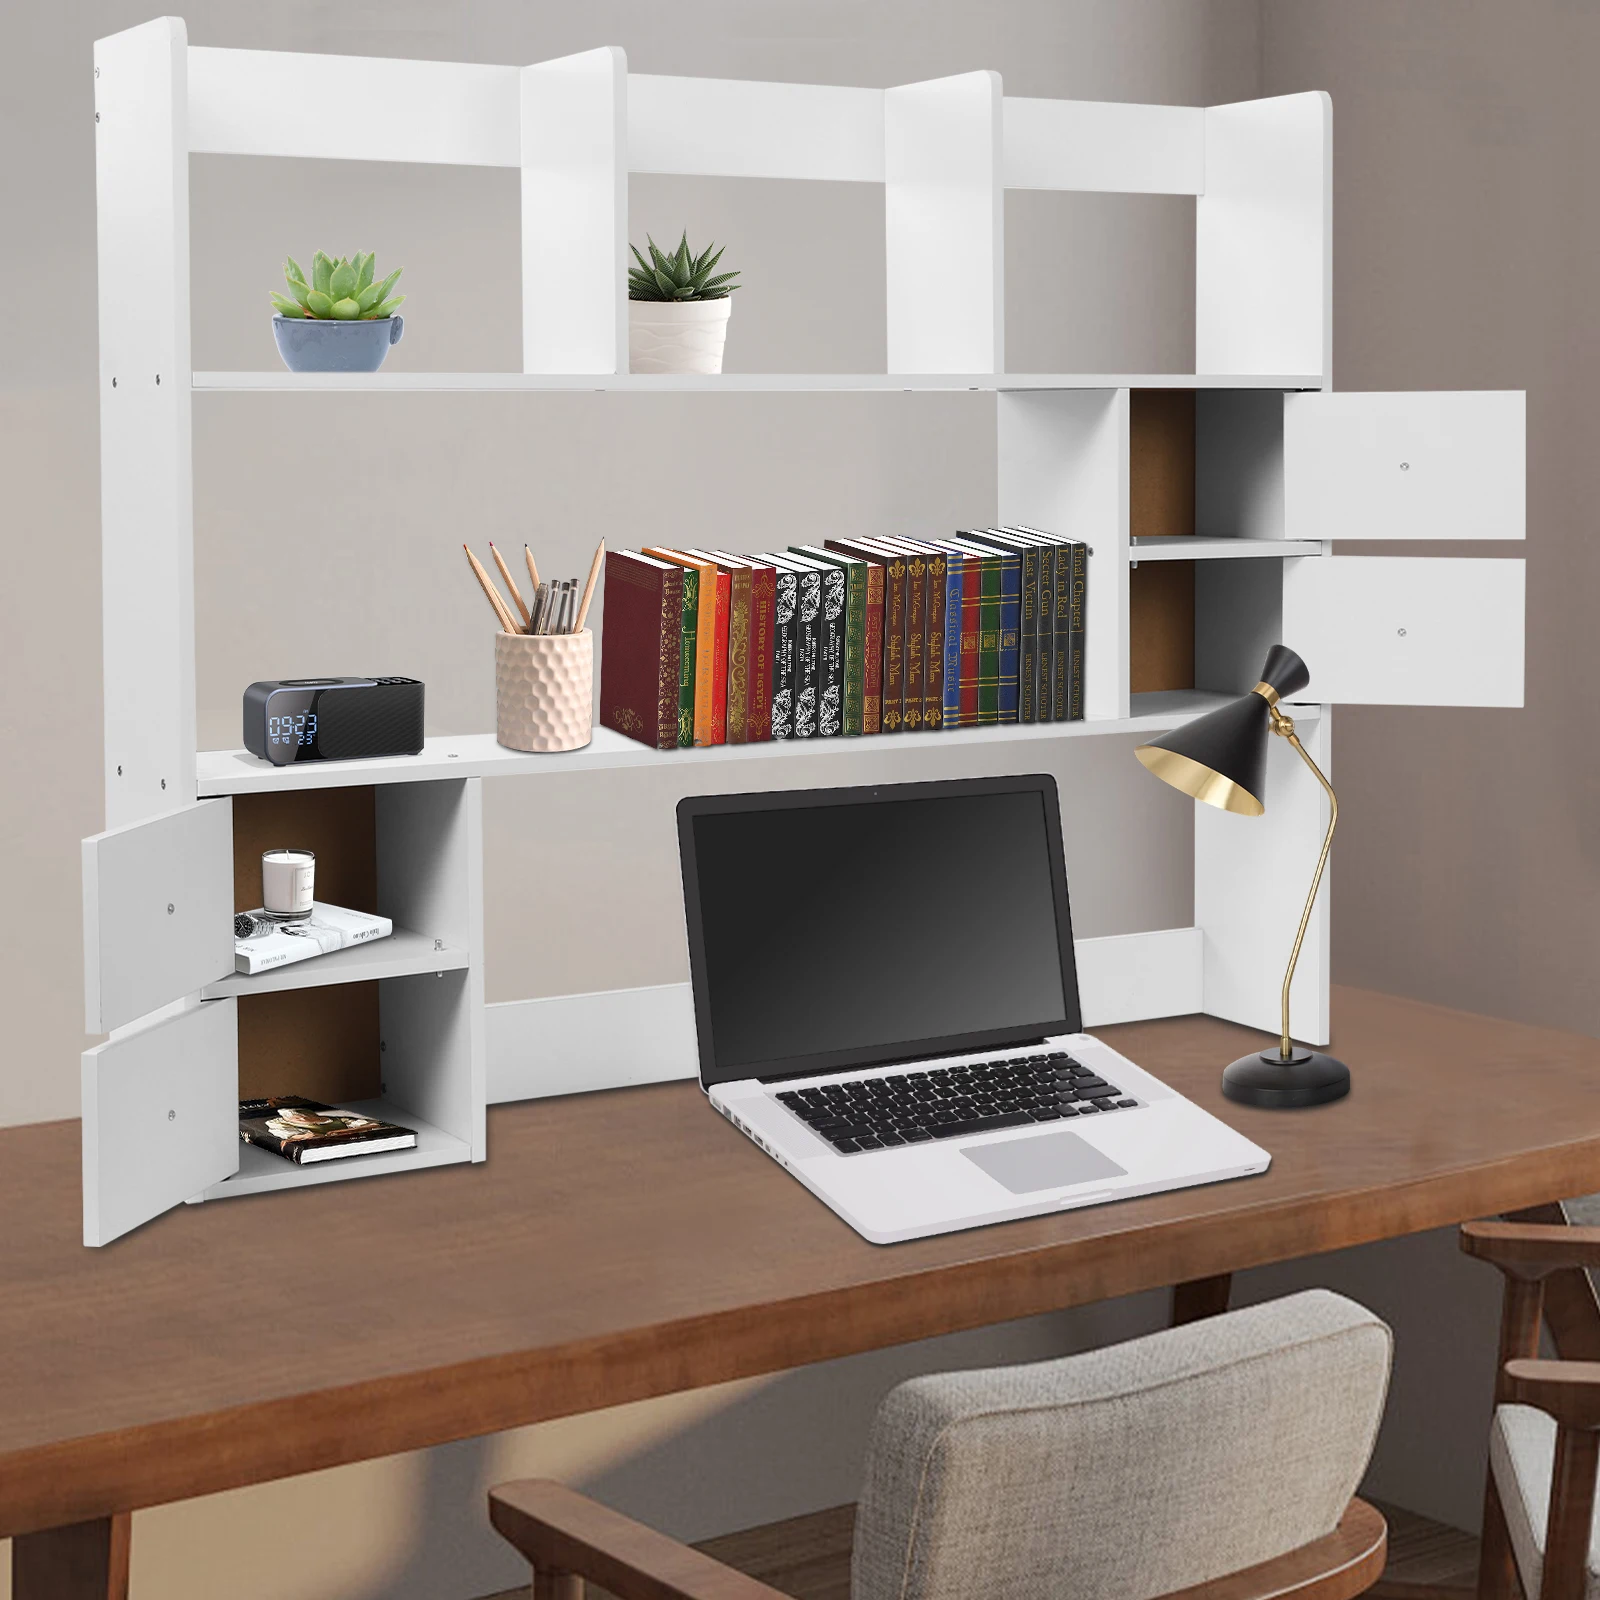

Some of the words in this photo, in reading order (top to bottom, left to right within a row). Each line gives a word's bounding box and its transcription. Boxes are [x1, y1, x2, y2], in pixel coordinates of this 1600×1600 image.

[1026, 553, 1037, 576] Last
[1042, 551, 1053, 586] Secret
[1056, 548, 1069, 576] Lady
[1074, 548, 1085, 576] Final
[1058, 580, 1068, 592] in
[1025, 581, 1036, 620] Victim
[1042, 590, 1052, 616] Gun
[1058, 595, 1068, 618] Red
[1071, 580, 1084, 628] Chapter
[758, 600, 767, 651] HISTORY
[949, 588, 960, 646] Classical
[888, 634, 902, 661] Stylish
[908, 633, 922, 660] Stylish
[928, 632, 942, 658] Stylish
[758, 654, 766, 670] OF
[948, 652, 958, 692] Music
[757, 672, 765, 710] EGYPT
[270, 714, 317, 736] 09:23
